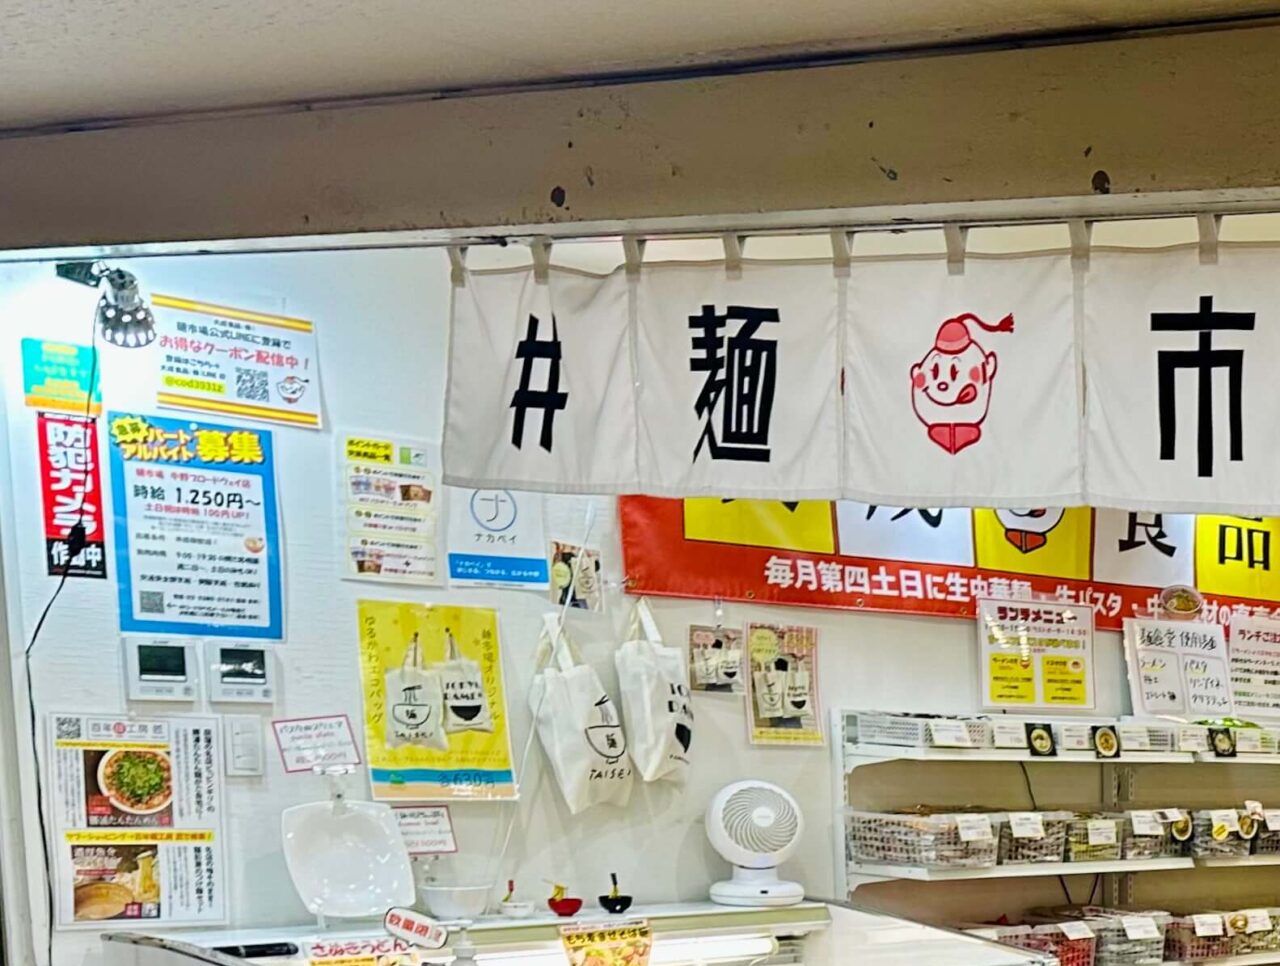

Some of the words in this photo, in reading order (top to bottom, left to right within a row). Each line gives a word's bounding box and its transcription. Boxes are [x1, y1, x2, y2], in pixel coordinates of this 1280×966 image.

[120, 442, 194, 460] アルバイト
[195, 430, 264, 463] 募集
[51, 541, 102, 568] 作中
